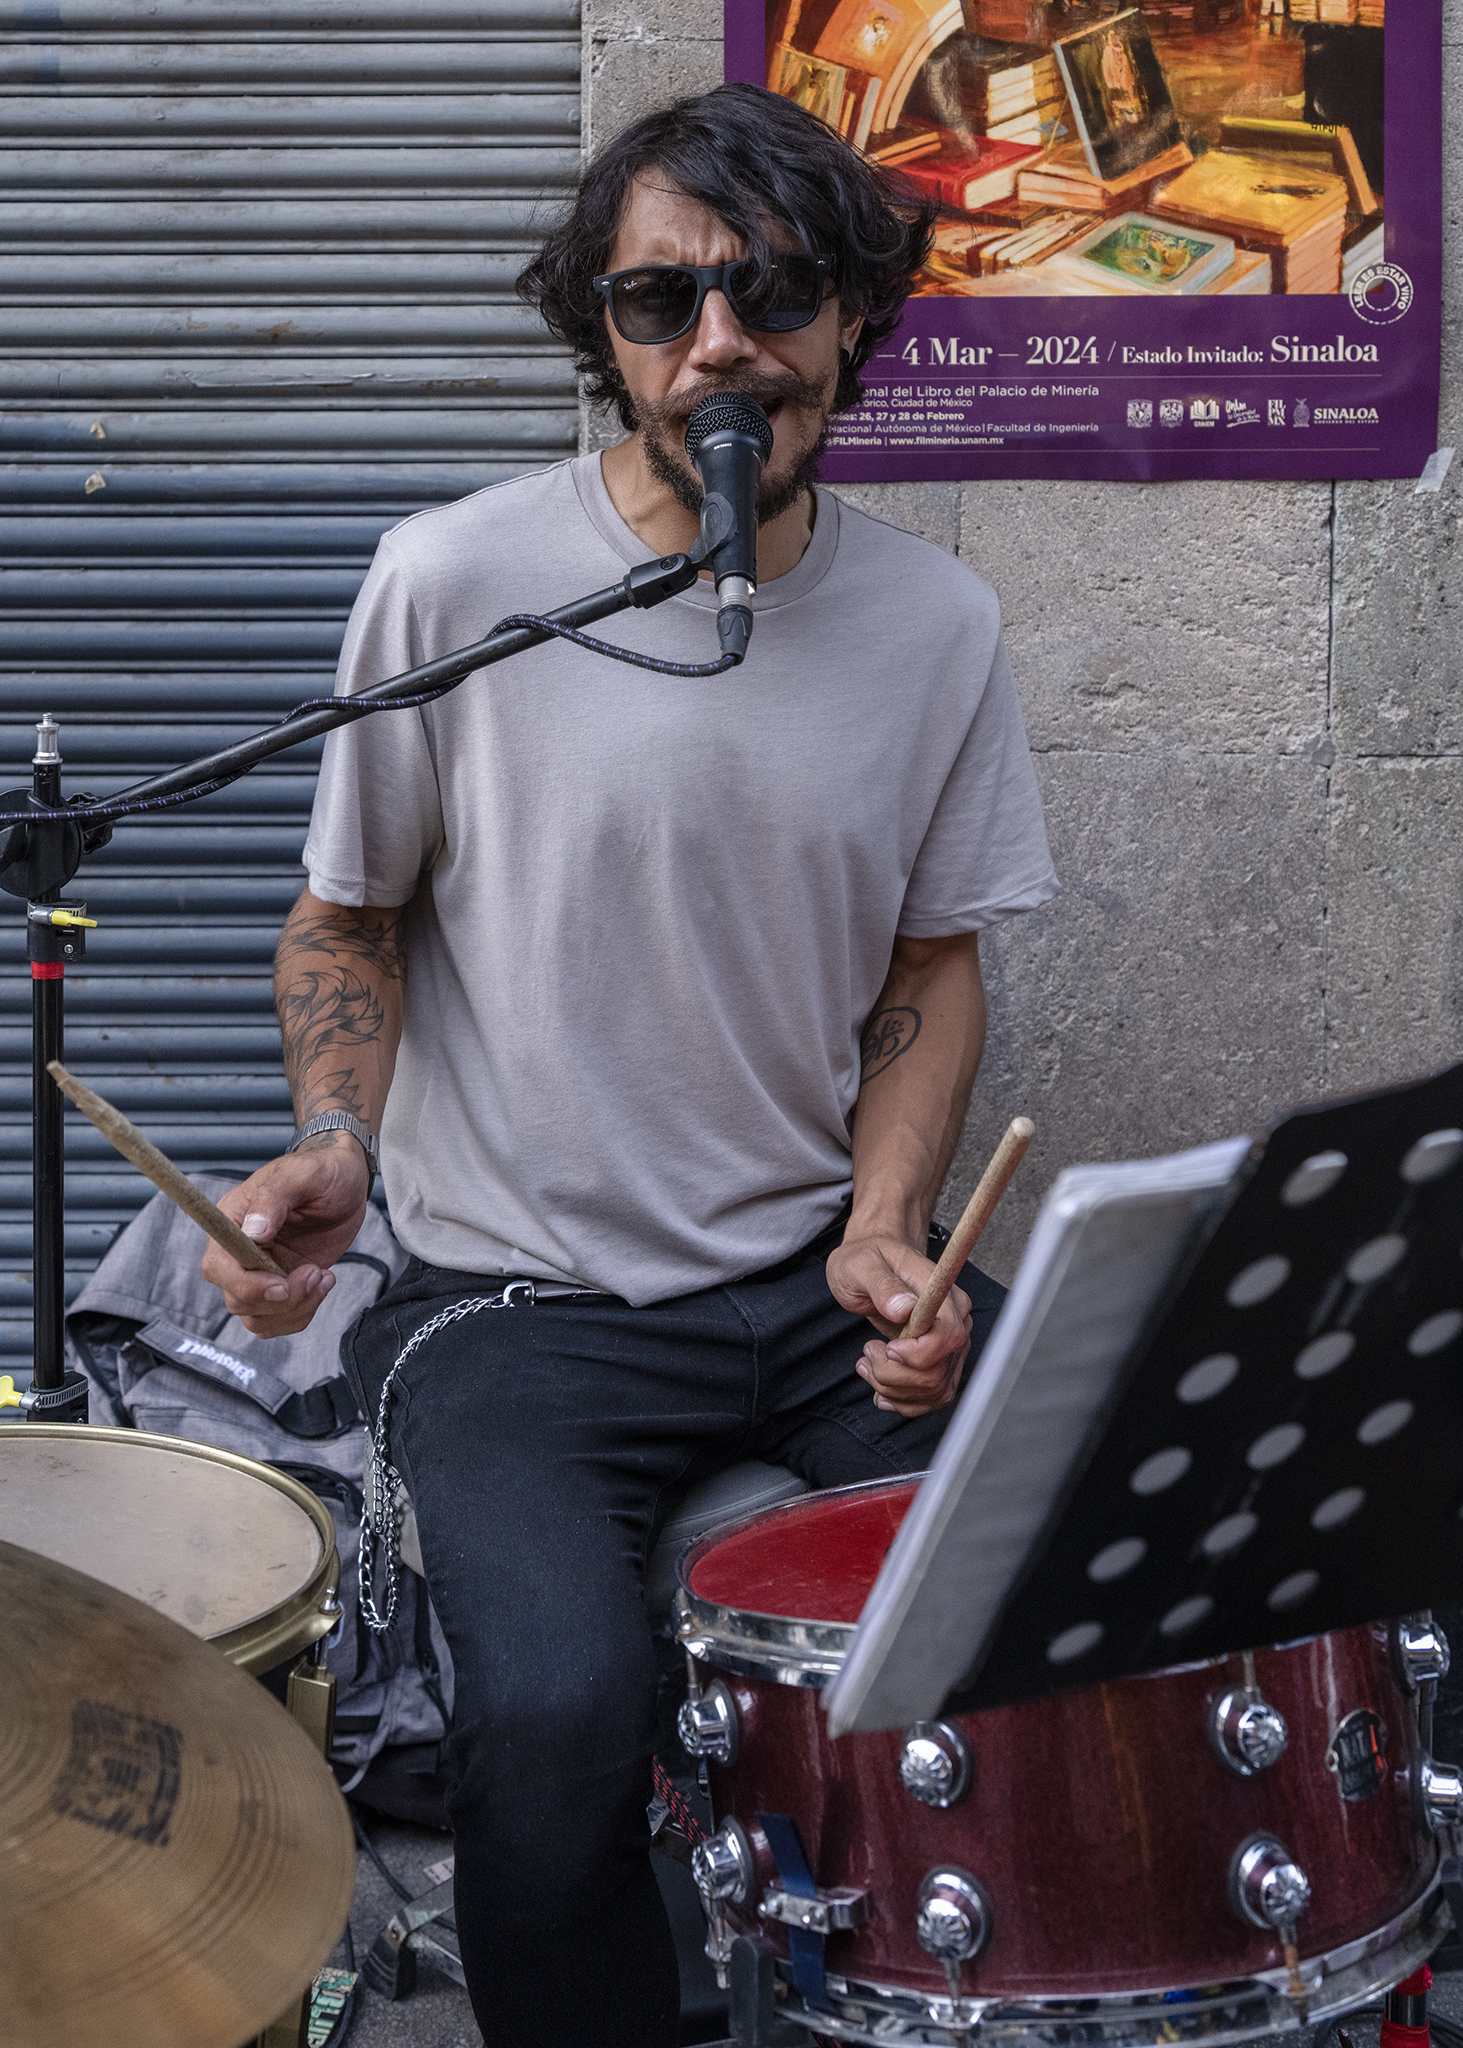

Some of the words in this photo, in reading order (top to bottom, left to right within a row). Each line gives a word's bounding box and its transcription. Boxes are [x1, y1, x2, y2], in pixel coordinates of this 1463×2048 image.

[1376, 266, 1406, 286] ESTAR
[1397, 285, 1410, 310] VIVO
[901, 337, 921, 365] 4
[928, 337, 993, 365] Mar
[1026, 336, 1100, 365] 2024
[1121, 346, 1183, 363] Estado
[1187, 345, 1264, 363] Invitado:
[1270, 335, 1380, 363] Sinaloa
[862, 385, 888, 397] onal
[892, 385, 913, 397] del
[917, 385, 951, 397] Libro
[955, 385, 975, 397] del
[979, 385, 1027, 397] Palacio
[1031, 385, 1048, 396] de
[1052, 384, 1099, 396] Minería
[891, 398, 924, 408] Ciudad
[925, 398, 938, 407] de
[940, 398, 973, 407] México
[859, 411, 874, 422] 26,
[876, 412, 888, 421] 27
[890, 413, 897, 422] y
[898, 411, 910, 421] 28
[912, 411, 925, 421] de
[926, 411, 965, 421] Febrero
[1314, 408, 1379, 419] SINALOA
[875, 423, 927, 433] Autónoma
[930, 423, 943, 433] de
[945, 423, 981, 433] México
[987, 423, 1031, 432] Facultad
[1033, 423, 1047, 432] de
[1049, 423, 1099, 434] Ingeniería
